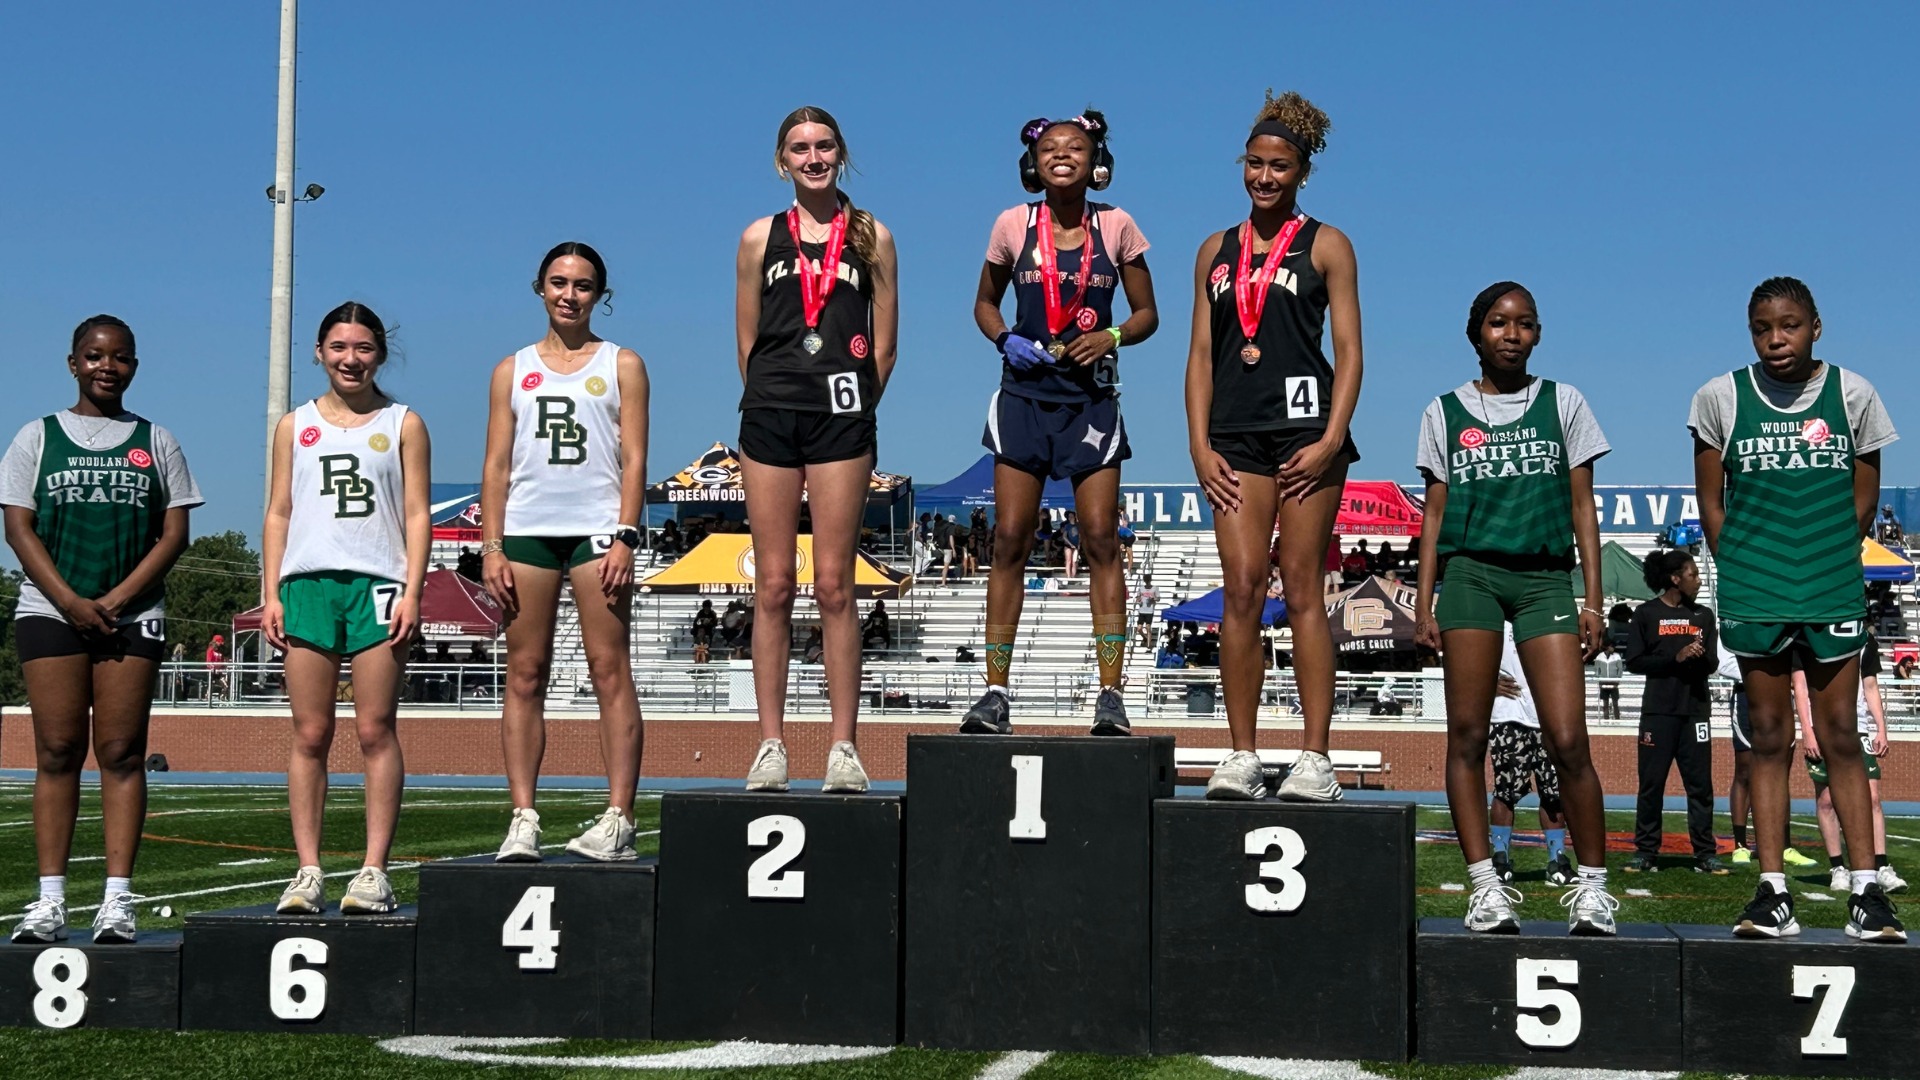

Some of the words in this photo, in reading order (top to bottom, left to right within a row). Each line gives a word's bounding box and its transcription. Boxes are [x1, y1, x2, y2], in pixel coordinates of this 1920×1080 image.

[834, 375, 856, 410] 6
[1290, 379, 1314, 415] 4
[1483, 427, 1537, 443] OODLAND
[1760, 420, 1803, 434] WOODL
[67, 456, 129, 468] WOODLAND
[1451, 440, 1561, 468] UNIFIED
[1739, 452, 1850, 473] TRACK
[46, 469, 151, 491] UNIFIED
[1452, 457, 1561, 485] TRACK
[48, 487, 149, 509] TRACK
[668, 488, 746, 503] GREENWOOD
[376, 587, 397, 622] 7
[420, 622, 465, 635] CHOOL
[1339, 640, 1366, 651] GOOSE
[1368, 638, 1395, 650] CREEK
[1698, 724, 1707, 740] 5
[1009, 754, 1047, 841] 1
[746, 815, 806, 900] 2
[1244, 826, 1307, 914] 3
[502, 886, 561, 972] 4
[32, 947, 89, 1029] 8
[269, 937, 330, 1022] 6
[1516, 958, 1581, 1049] 5
[1791, 964, 1856, 1057] 7
